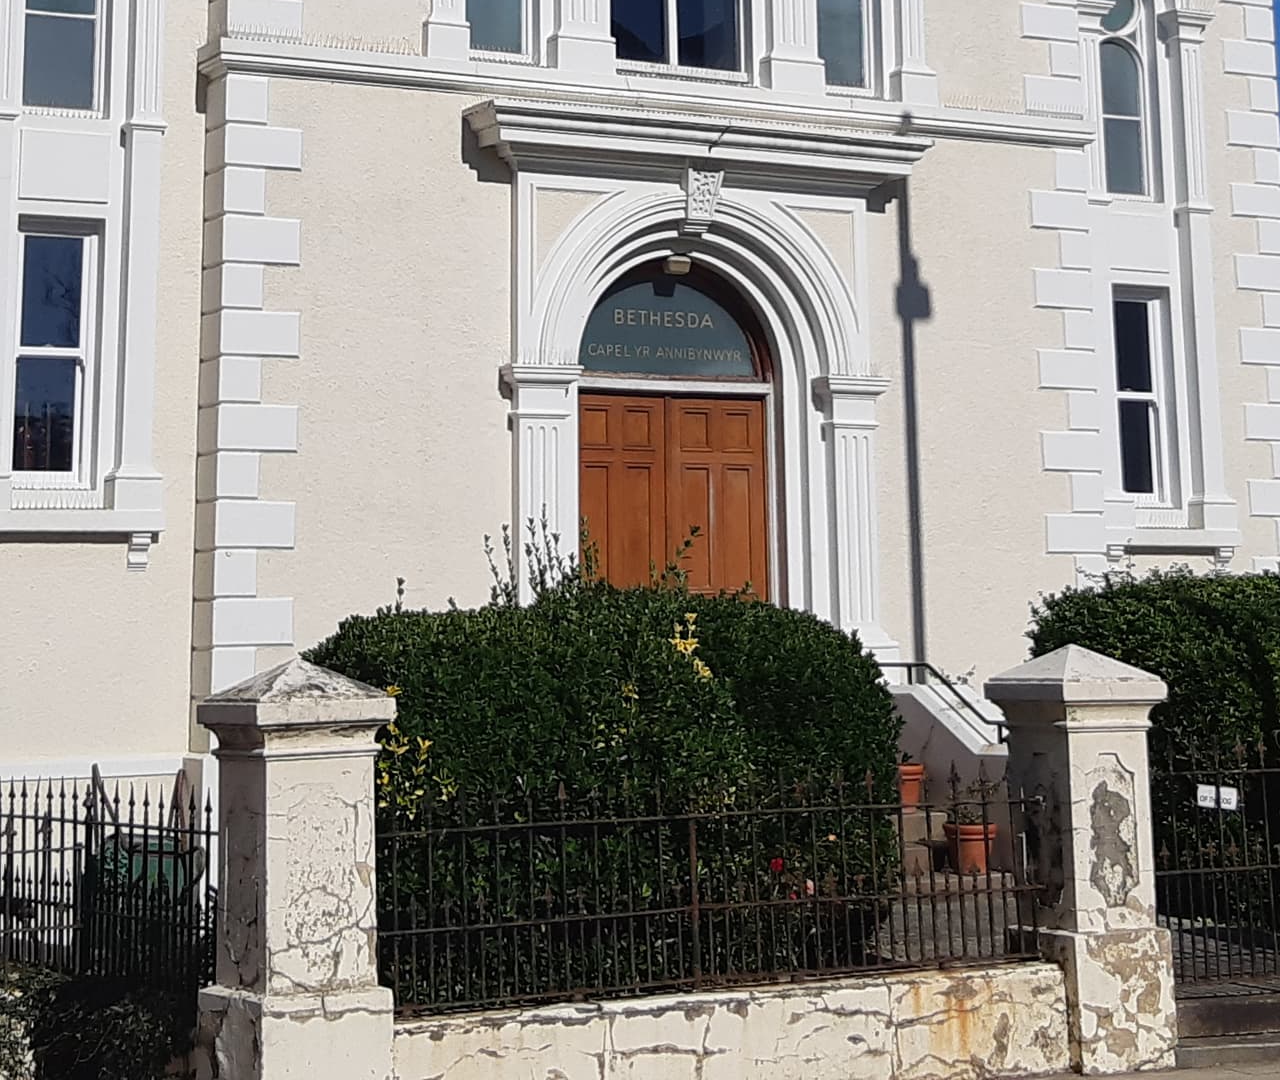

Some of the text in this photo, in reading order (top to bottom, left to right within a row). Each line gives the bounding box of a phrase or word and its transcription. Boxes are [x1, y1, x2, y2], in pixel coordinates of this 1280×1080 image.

[614, 308, 714, 329] BETHESDA
[587, 343, 742, 362] CAPEL YR ANNIBYNWYR
